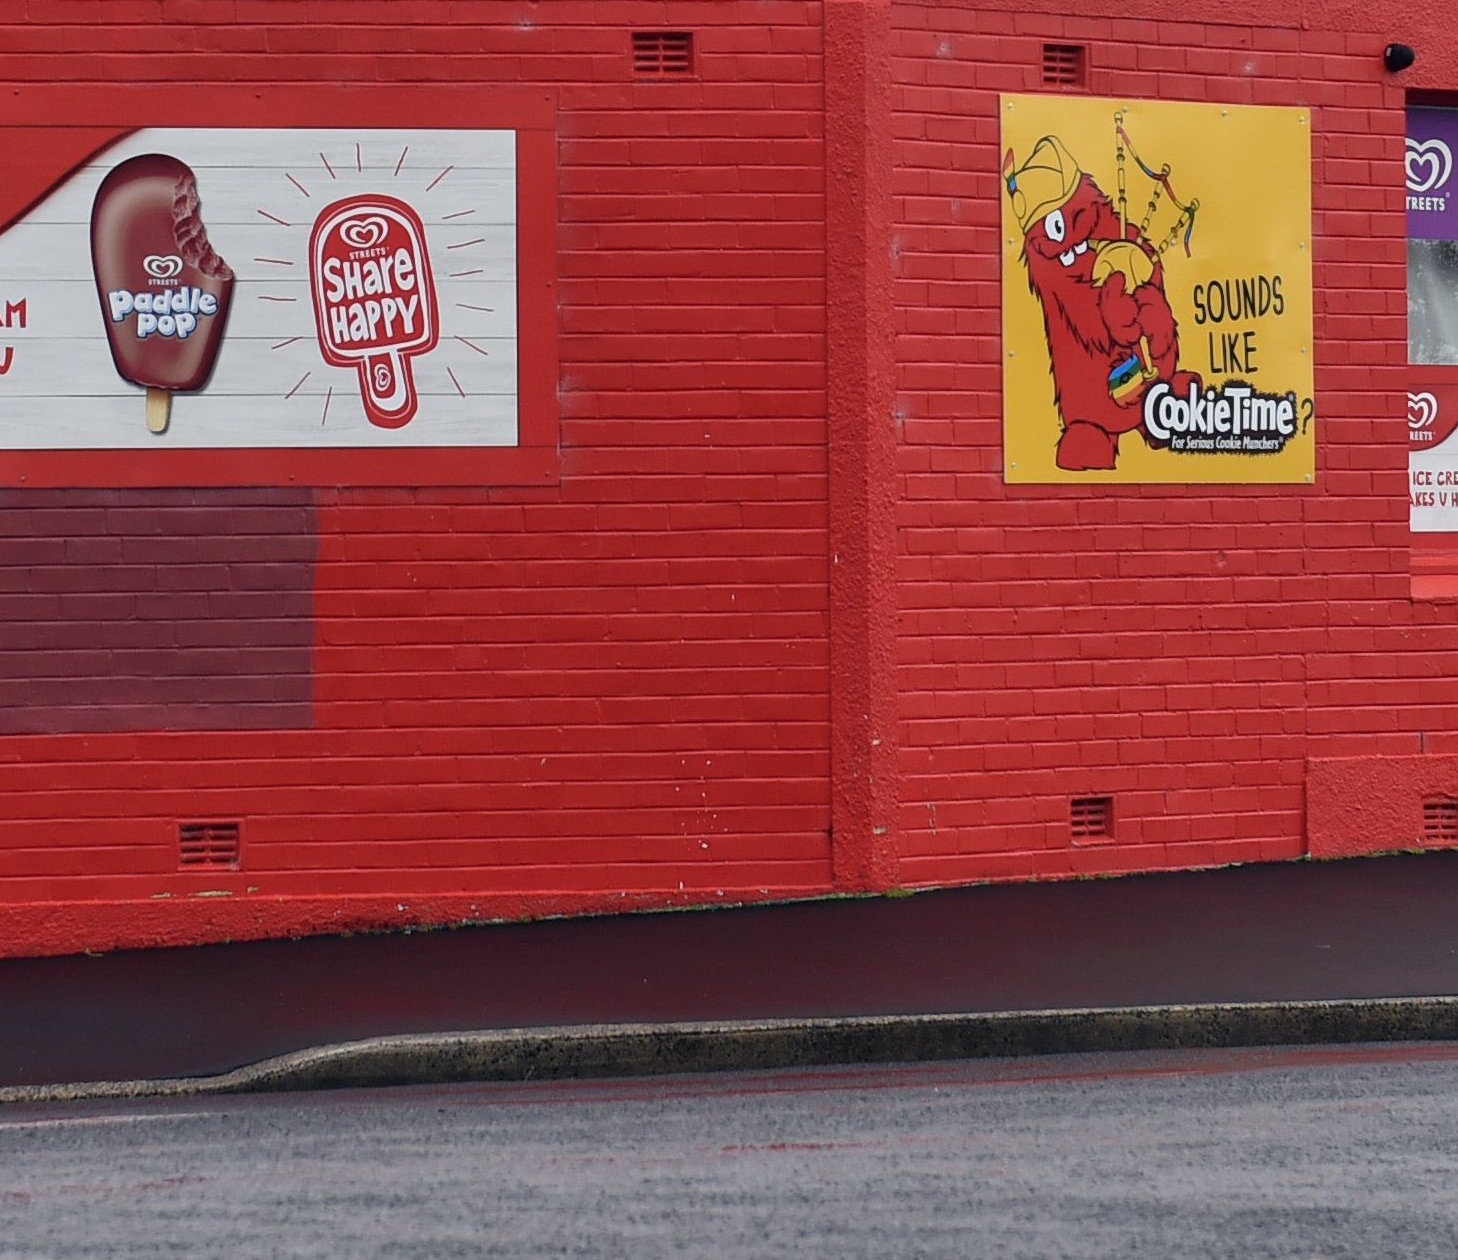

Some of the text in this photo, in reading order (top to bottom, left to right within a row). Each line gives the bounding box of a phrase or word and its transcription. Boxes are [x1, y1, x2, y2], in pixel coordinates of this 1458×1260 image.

[1405, 196, 1445, 211] TREETS
[348, 247, 386, 260] STREETS
[1193, 275, 1284, 325] SOUNDS
[1208, 331, 1259, 374] LIKE
[1171, 436, 1279, 450] For Serious Cookie Munchers
[1412, 471, 1433, 486] ICE
[1409, 492, 1435, 507] AKES
[1439, 492, 1448, 507] U
